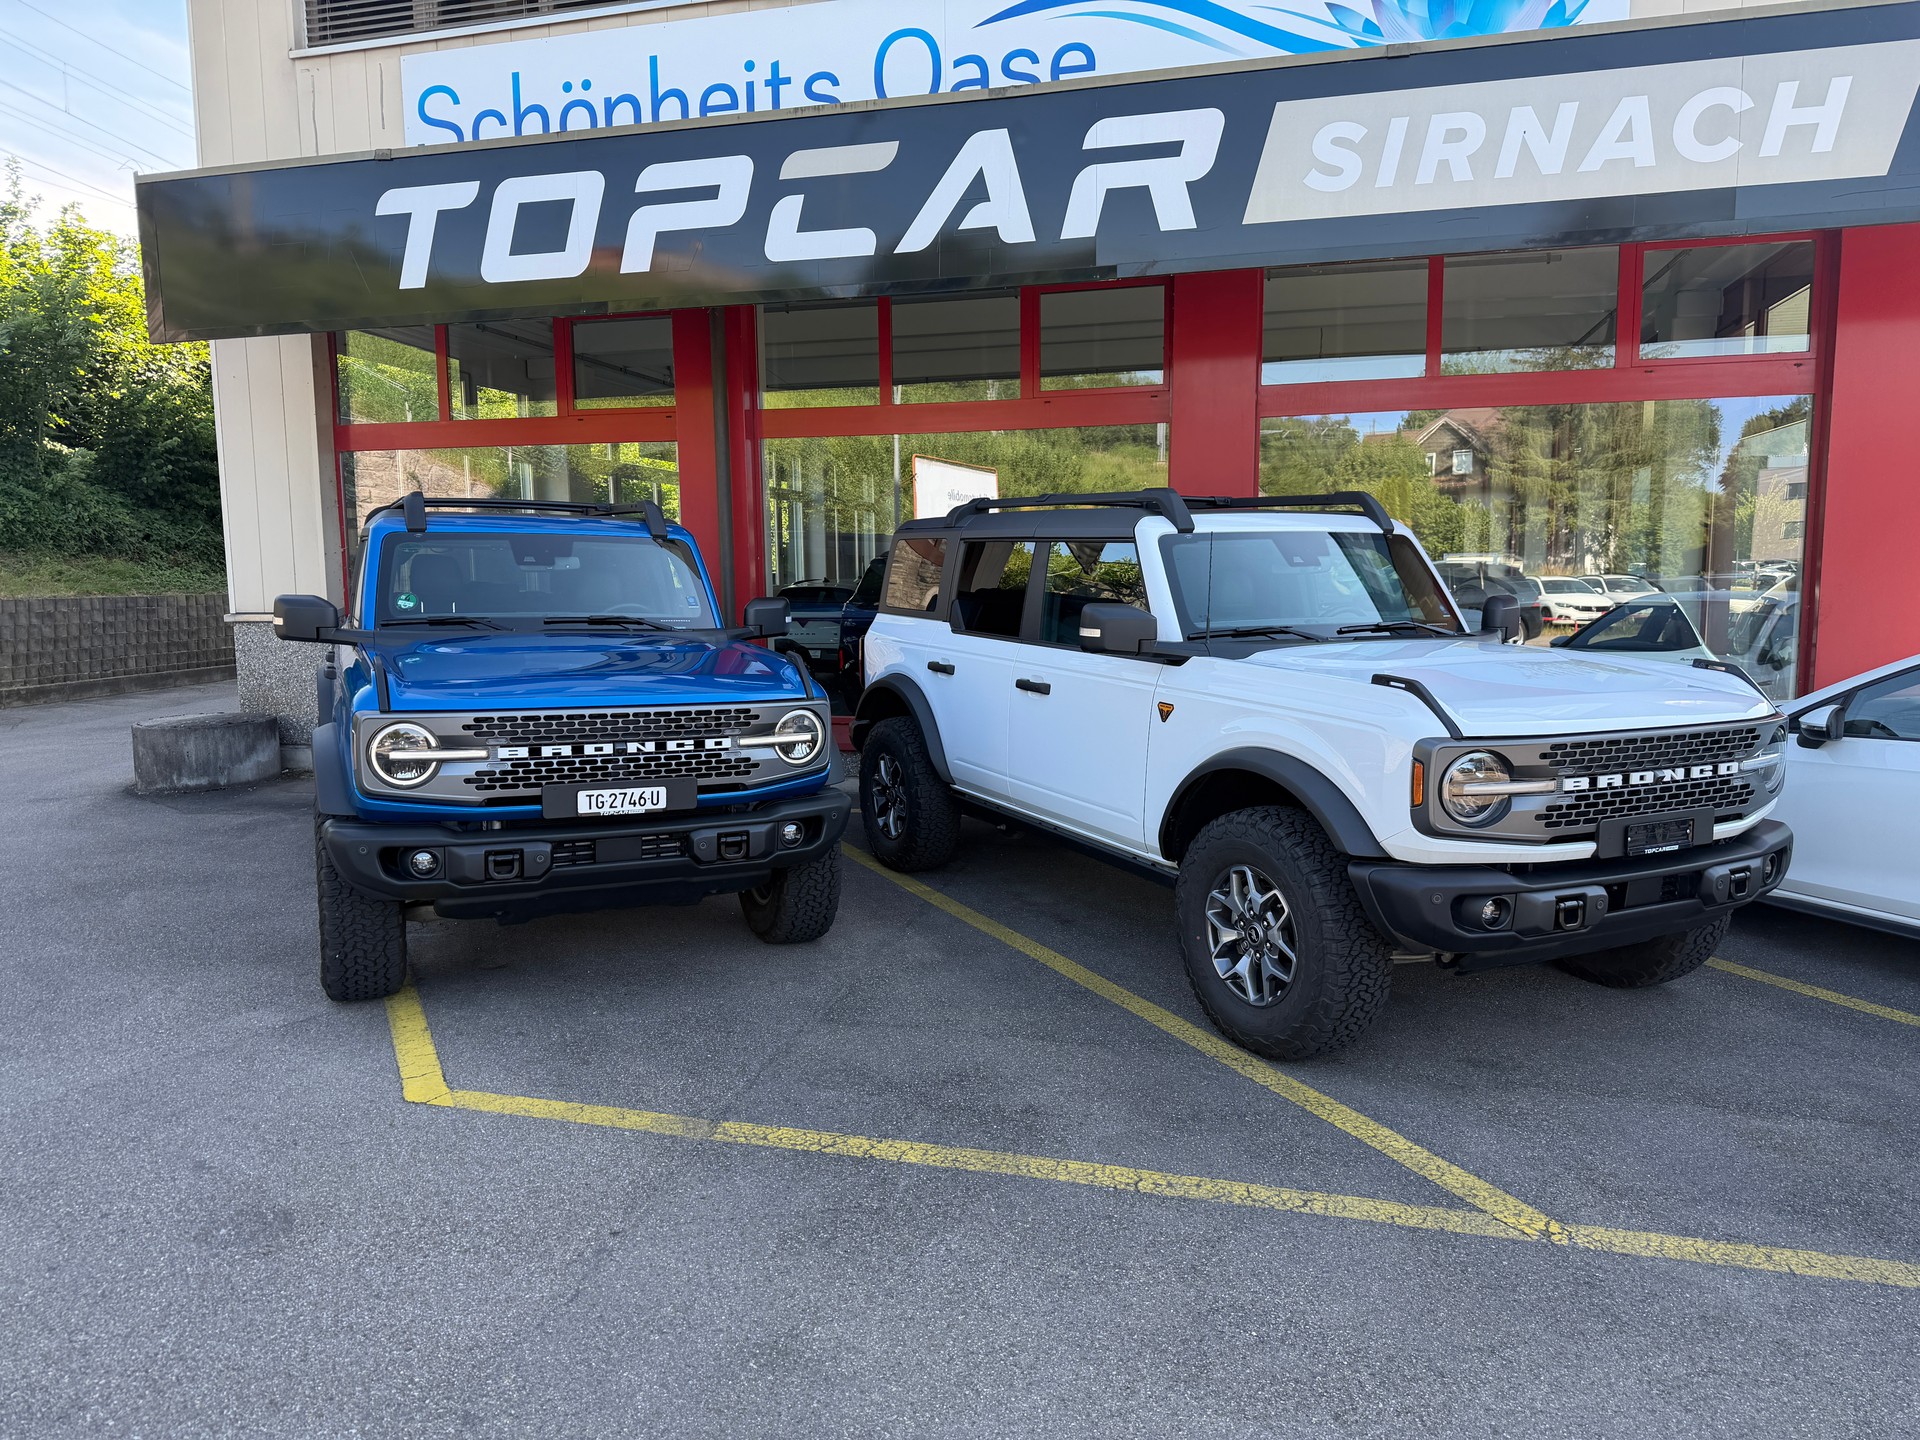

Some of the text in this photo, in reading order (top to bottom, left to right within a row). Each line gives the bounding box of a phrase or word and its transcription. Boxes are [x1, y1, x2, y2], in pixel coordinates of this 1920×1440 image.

[874, 27, 1096, 99] Oase
[376, 76, 1853, 290] TOPCAR SIRNACH
[498, 738, 731, 759] BRONCO
[1562, 761, 1739, 791] BRONCO
[1644, 846, 1666, 854] TOPCAR
